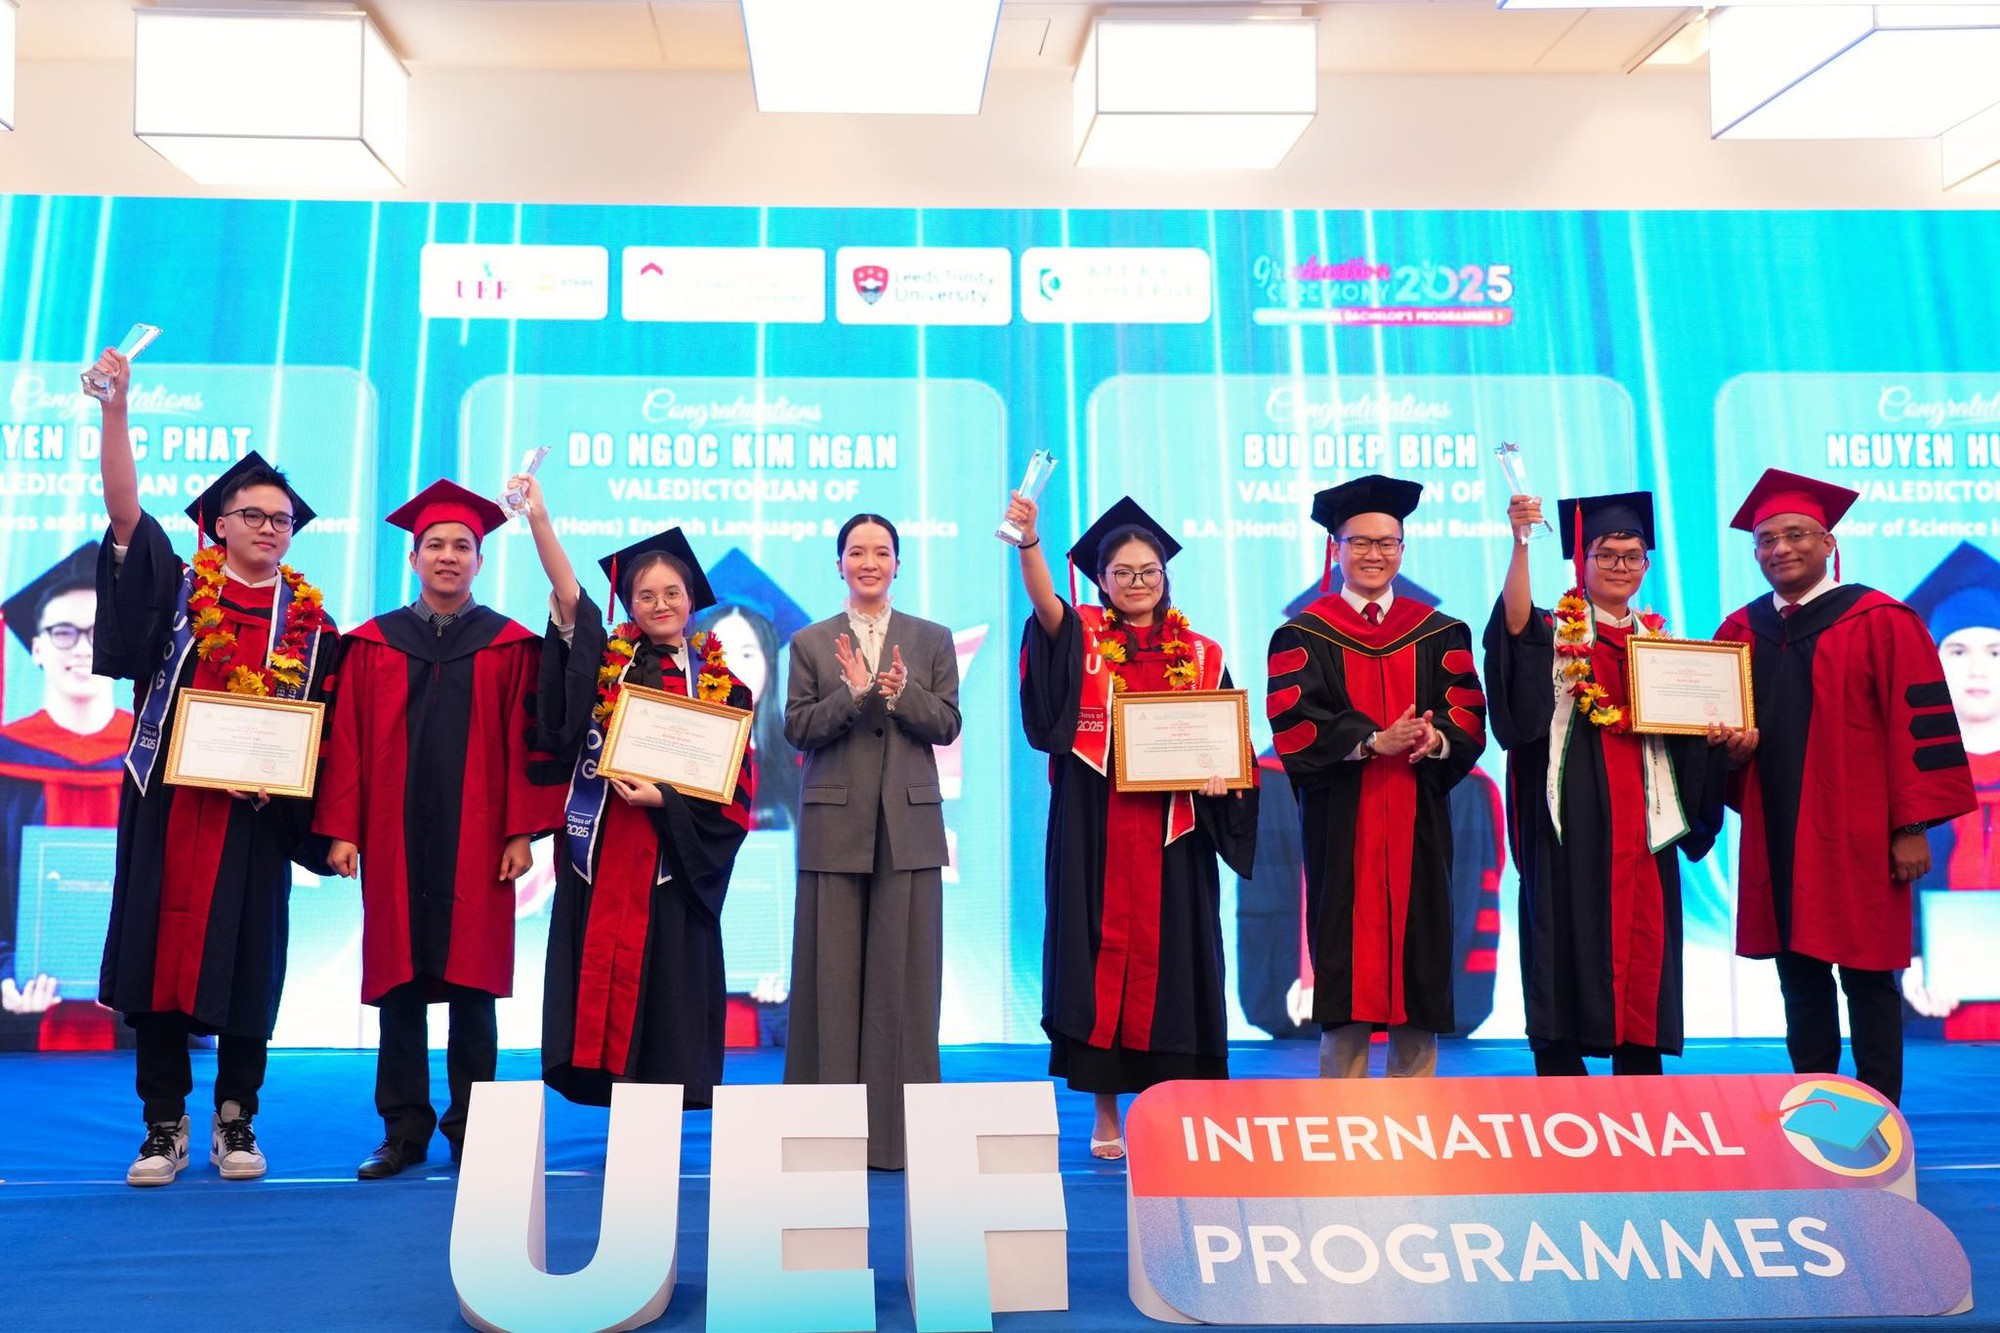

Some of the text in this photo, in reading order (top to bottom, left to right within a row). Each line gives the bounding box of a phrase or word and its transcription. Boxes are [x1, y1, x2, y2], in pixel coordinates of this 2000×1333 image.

[1395, 260, 1513, 302] 2025
[894, 288, 989, 305] University
[79, 426, 148, 461] DC
[163, 426, 252, 462] PHAT
[568, 432, 898, 470] DO NGOC KIM NGAN
[1244, 434, 1477, 468] BUI DIEP BICH
[1827, 433, 1954, 468] NGUYEN
[608, 477, 860, 503] VALEDICTORIAN OF
[1450, 480, 1486, 504] OF
[1881, 518, 1906, 537] of
[1908, 518, 1987, 537] Science
[1076, 720, 1104, 733] 2025
[139, 735, 156, 750] 2025
[566, 823, 590, 838] 2025
[567, 814, 584, 825] Class
[1182, 1110, 1746, 1163] INTERNATIONAL
[449, 1080, 1069, 1333] UEF
[1193, 1217, 1847, 1285] PROGRAMMES
